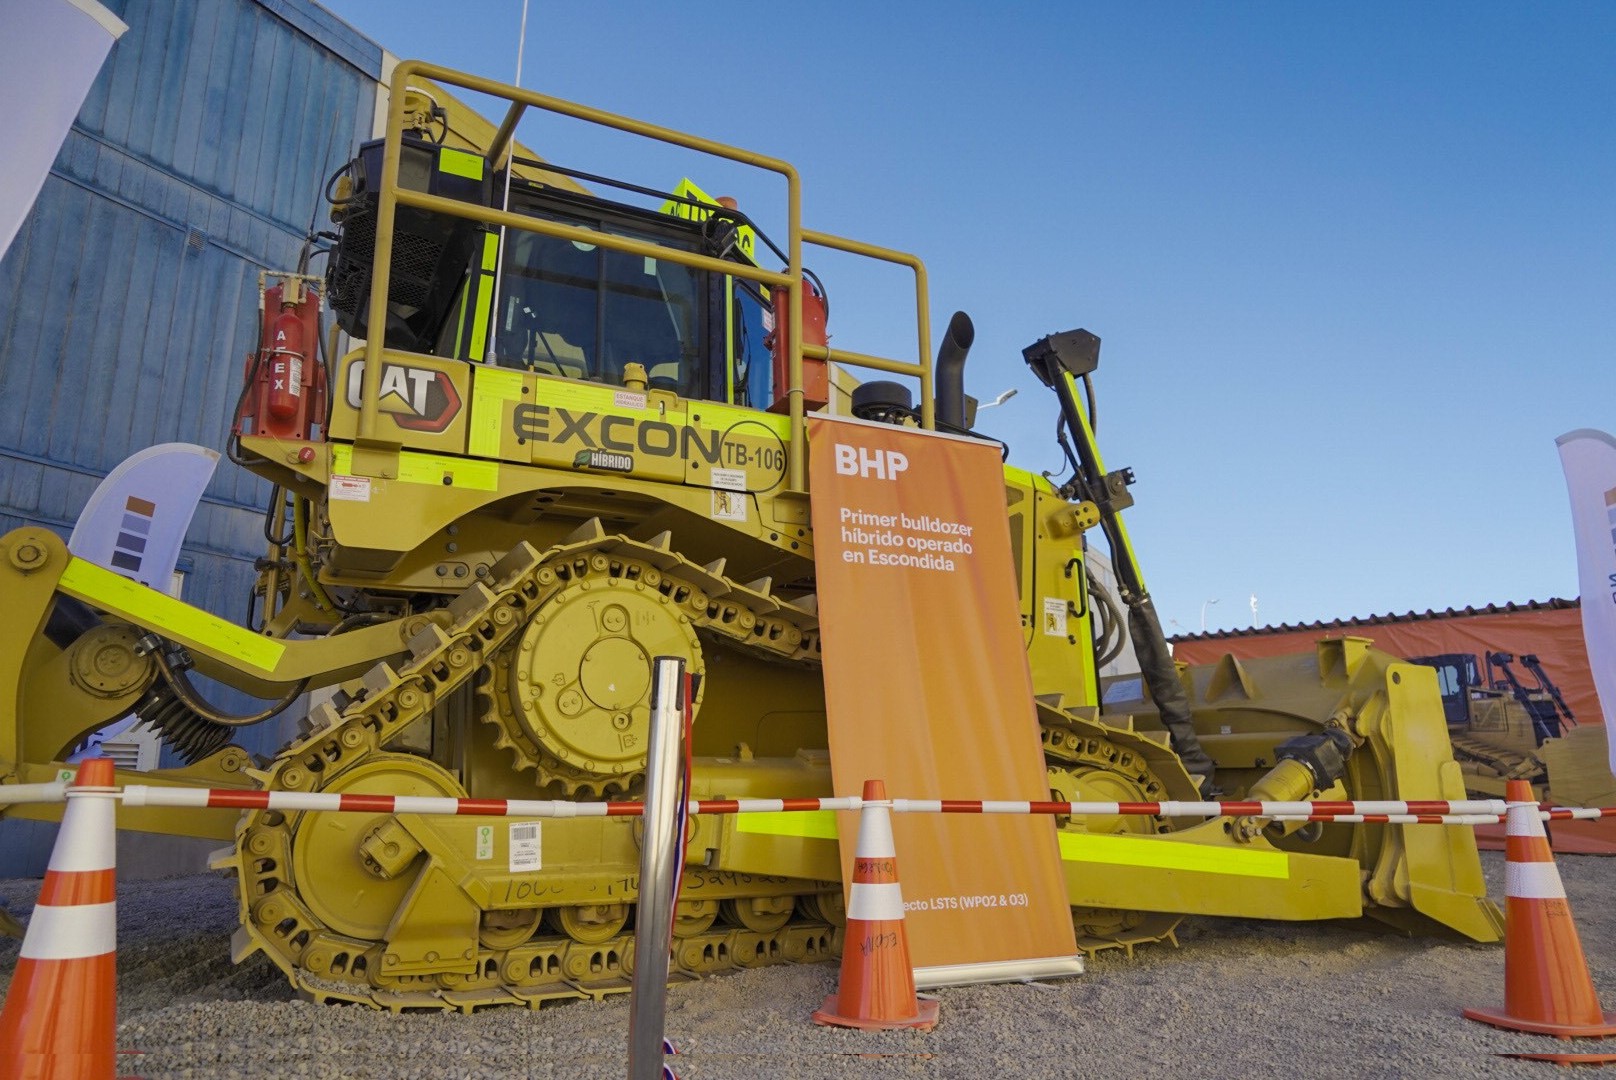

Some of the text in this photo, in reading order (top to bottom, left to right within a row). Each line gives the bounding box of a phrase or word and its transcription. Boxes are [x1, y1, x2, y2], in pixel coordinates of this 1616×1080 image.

[513, 403, 720, 464] EXCON
[591, 450, 632, 471] HÍBRIDO
[724, 440, 784, 472] TB-106
[834, 443, 909, 481] BHP
[840, 507, 973, 537] Primer bulldozer
[841, 526, 973, 555] híbrido operado
[842, 549, 955, 572] en Escondida
[903, 901, 928, 911] ecto
[930, 898, 957, 910] LSTS
[999, 895, 1008, 906] &
